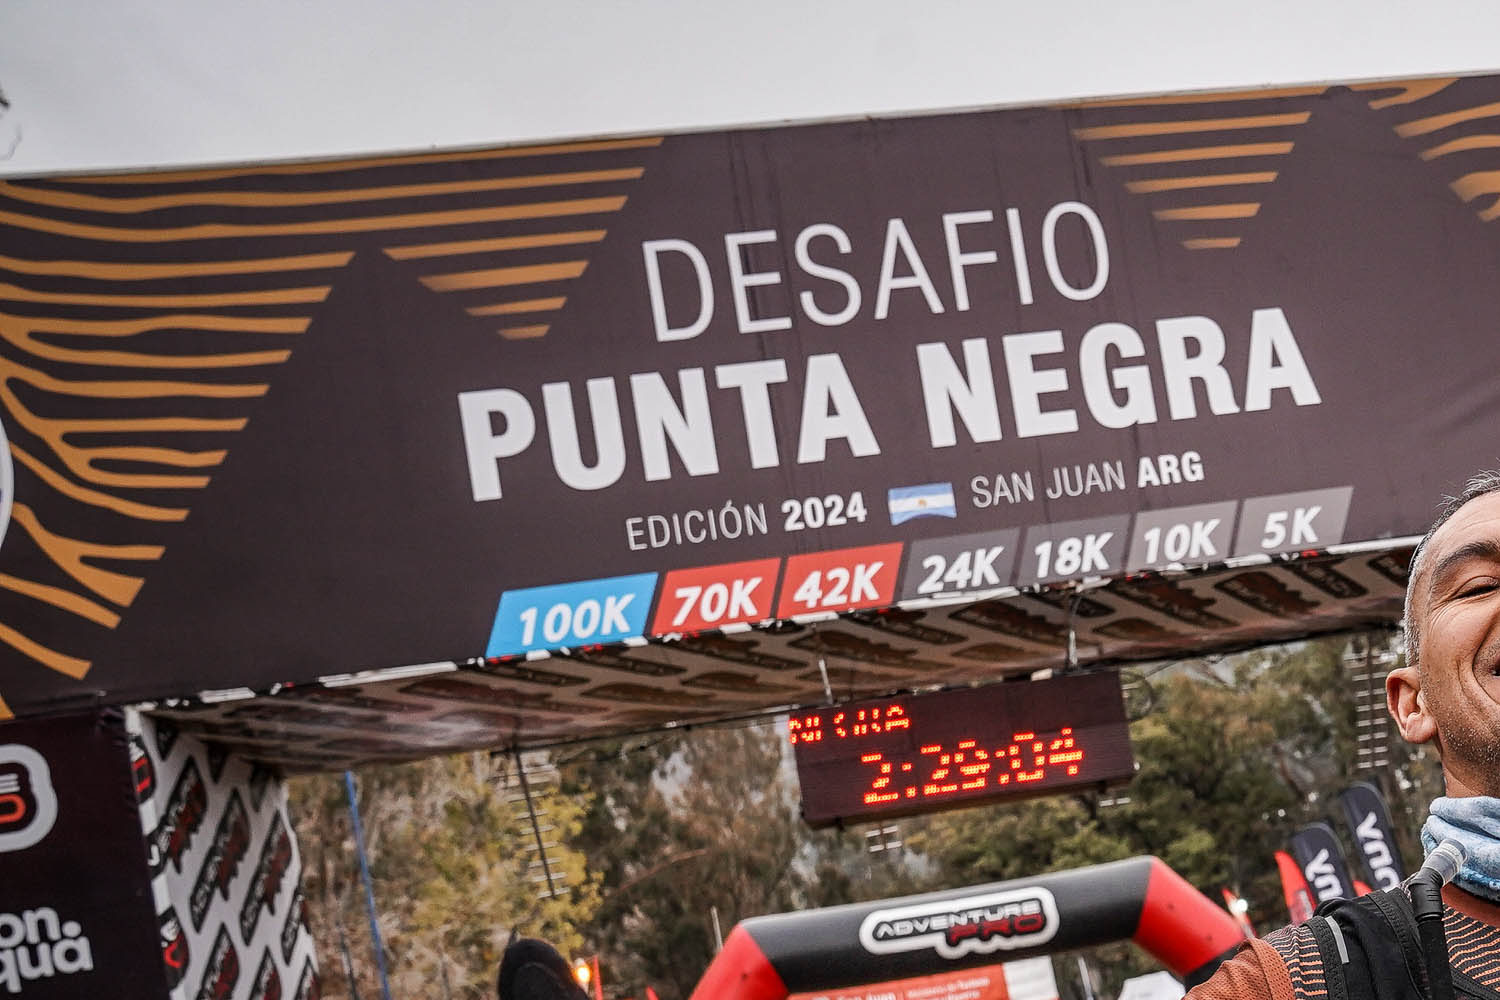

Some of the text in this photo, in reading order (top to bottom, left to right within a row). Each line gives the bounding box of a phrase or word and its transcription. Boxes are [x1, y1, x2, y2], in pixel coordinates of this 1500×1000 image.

[642, 201, 1111, 341] DESAFIO
[457, 308, 1322, 502] PUNTA NEGRA
[970, 451, 1205, 510] SAN JUAN ARG
[625, 490, 868, 551] EDICIÓN 2024
[1142, 519, 1217, 567] 10K
[1261, 507, 1321, 550] 5K
[918, 546, 1006, 592] 24K
[1033, 533, 1116, 576] 18K
[673, 577, 760, 627] 70K
[793, 561, 884, 610] 42K
[517, 591, 636, 648] 100K
[862, 728, 1083, 804] 2:29:04
[877, 900, 1041, 939] ADVENTURE
[950, 913, 1044, 945] PRO
